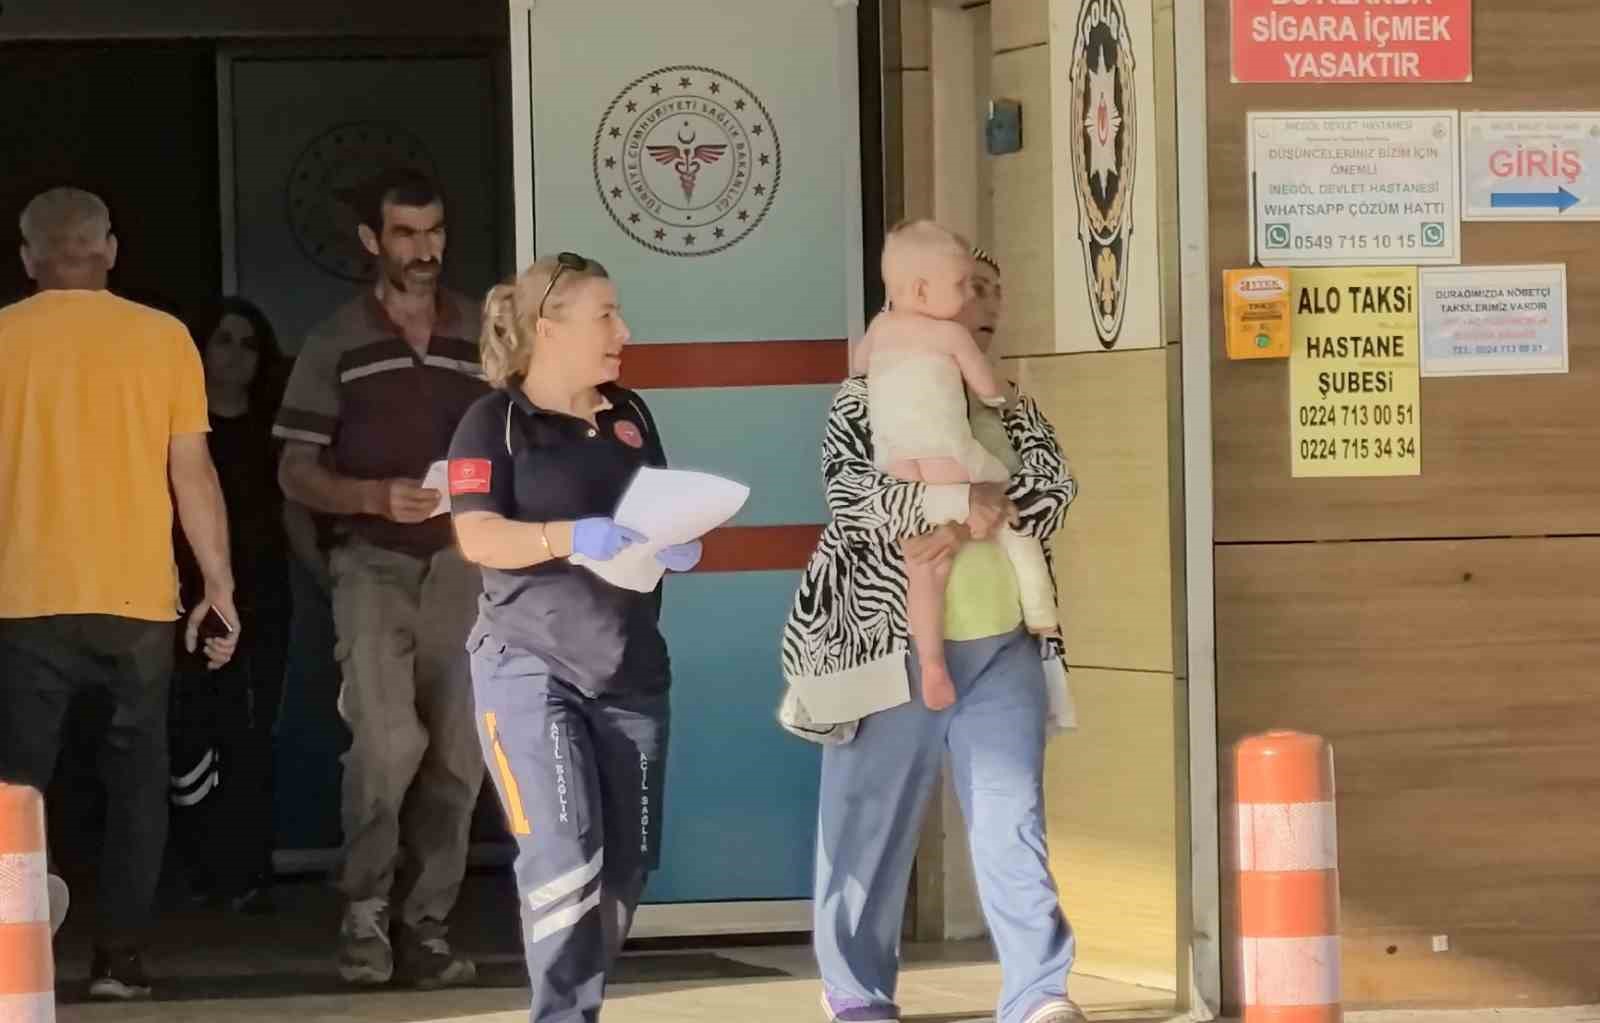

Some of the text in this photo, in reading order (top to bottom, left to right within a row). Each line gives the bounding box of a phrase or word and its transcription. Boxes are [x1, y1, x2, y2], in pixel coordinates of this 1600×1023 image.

[1251, 10, 1452, 48] SİGARA İÇMEK
[1283, 52, 1422, 78] YASAKTIR
[1488, 143, 1583, 184] GİRİŞ
[1319, 183, 1365, 194] DEVLET
[1370, 181, 1440, 194] HASTANESİ
[1264, 203, 1345, 217] WHATSAPP
[1348, 201, 1400, 218] ÇÖZÜM
[1294, 235, 1416, 249] 0549 715 10 15
[1297, 286, 1340, 314] ALO
[1306, 335, 1405, 359] HASTANE
[1299, 403, 1413, 426] 0224 713 00 51
[1300, 436, 1416, 460] 0224 715 34 34
